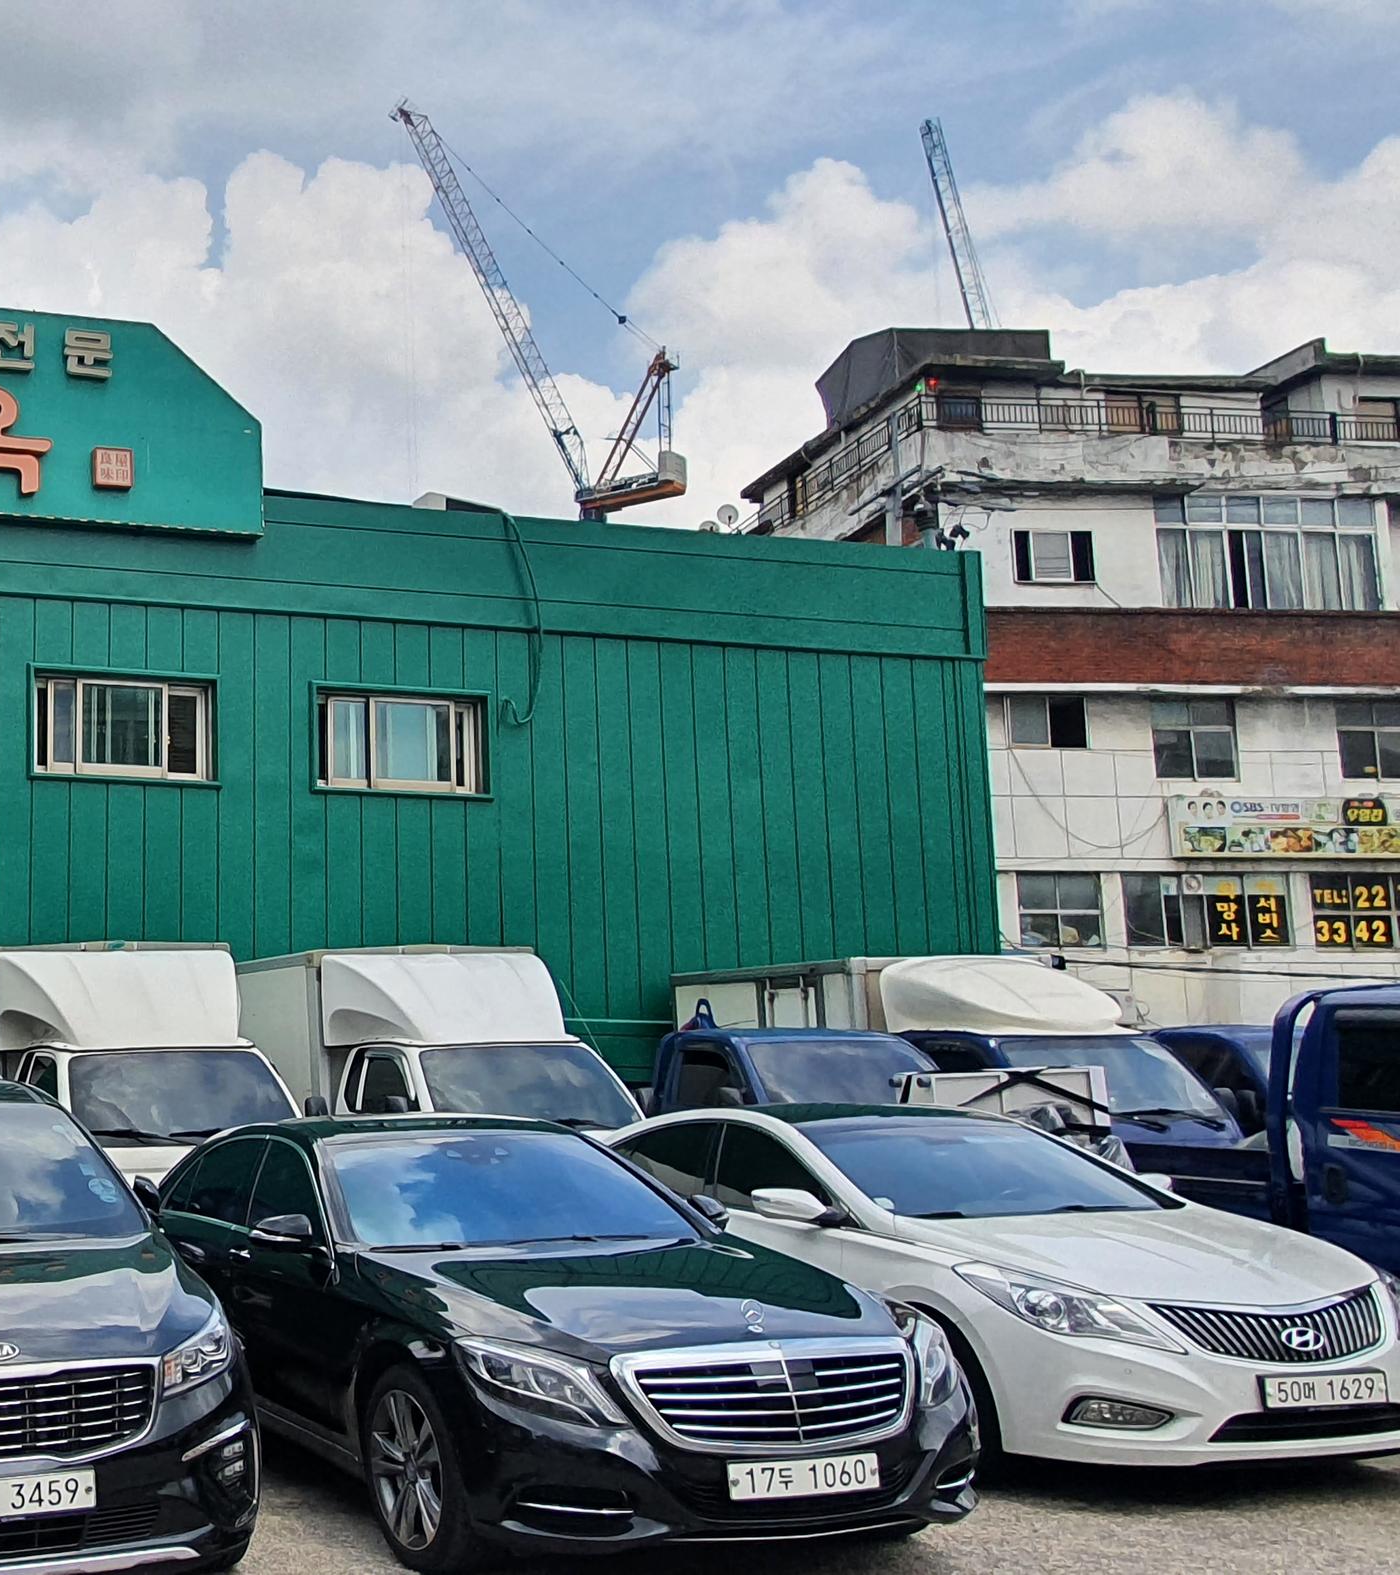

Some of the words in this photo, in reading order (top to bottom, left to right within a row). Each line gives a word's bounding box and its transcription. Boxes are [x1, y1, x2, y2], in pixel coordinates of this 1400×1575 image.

[1327, 1377, 1375, 1401] 1629
[745, 1467, 794, 1494] 17두
[808, 1459, 866, 1489] 1060
[10, 1478, 79, 1510] 3459
